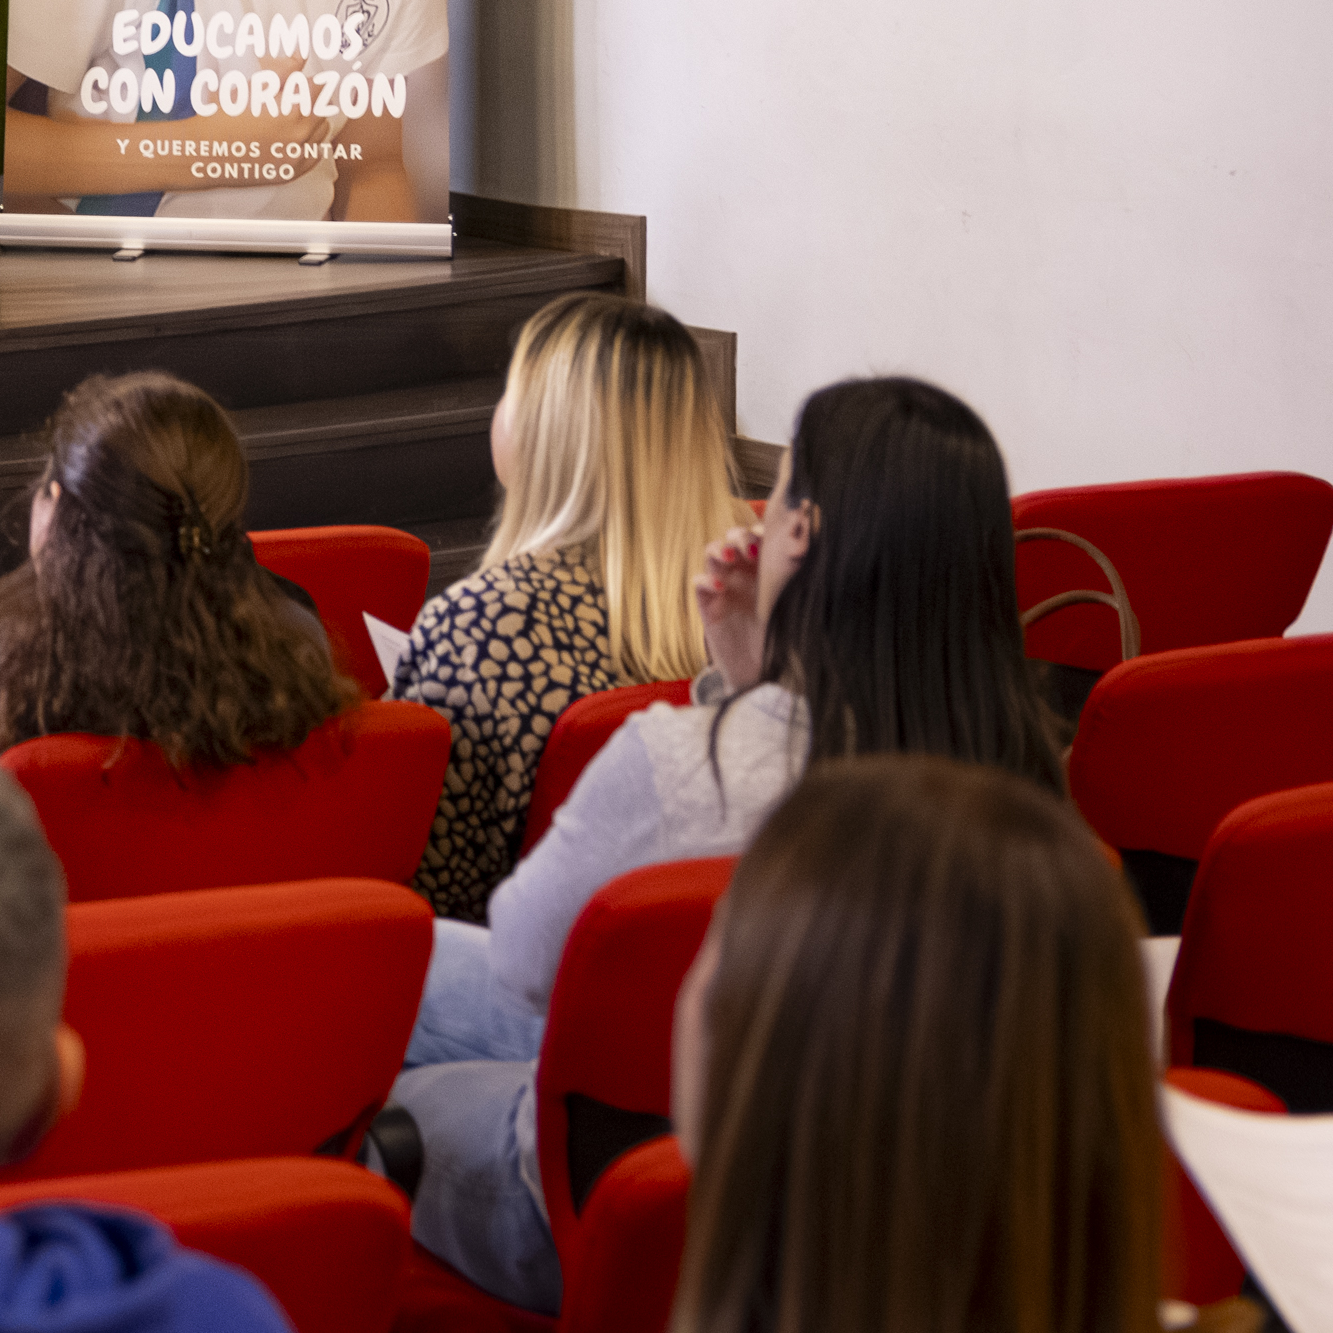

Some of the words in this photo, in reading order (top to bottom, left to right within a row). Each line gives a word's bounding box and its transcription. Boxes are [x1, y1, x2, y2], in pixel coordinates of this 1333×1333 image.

[111, 8, 367, 62] EDUCAMOS
[80, 66, 176, 115] CON
[190, 61, 407, 119] CORAZÓN
[115, 138, 130, 155] Y
[139, 139, 261, 160] QUEREMOS
[270, 141, 363, 161] CONTAR
[191, 161, 295, 181] CONTIGO
